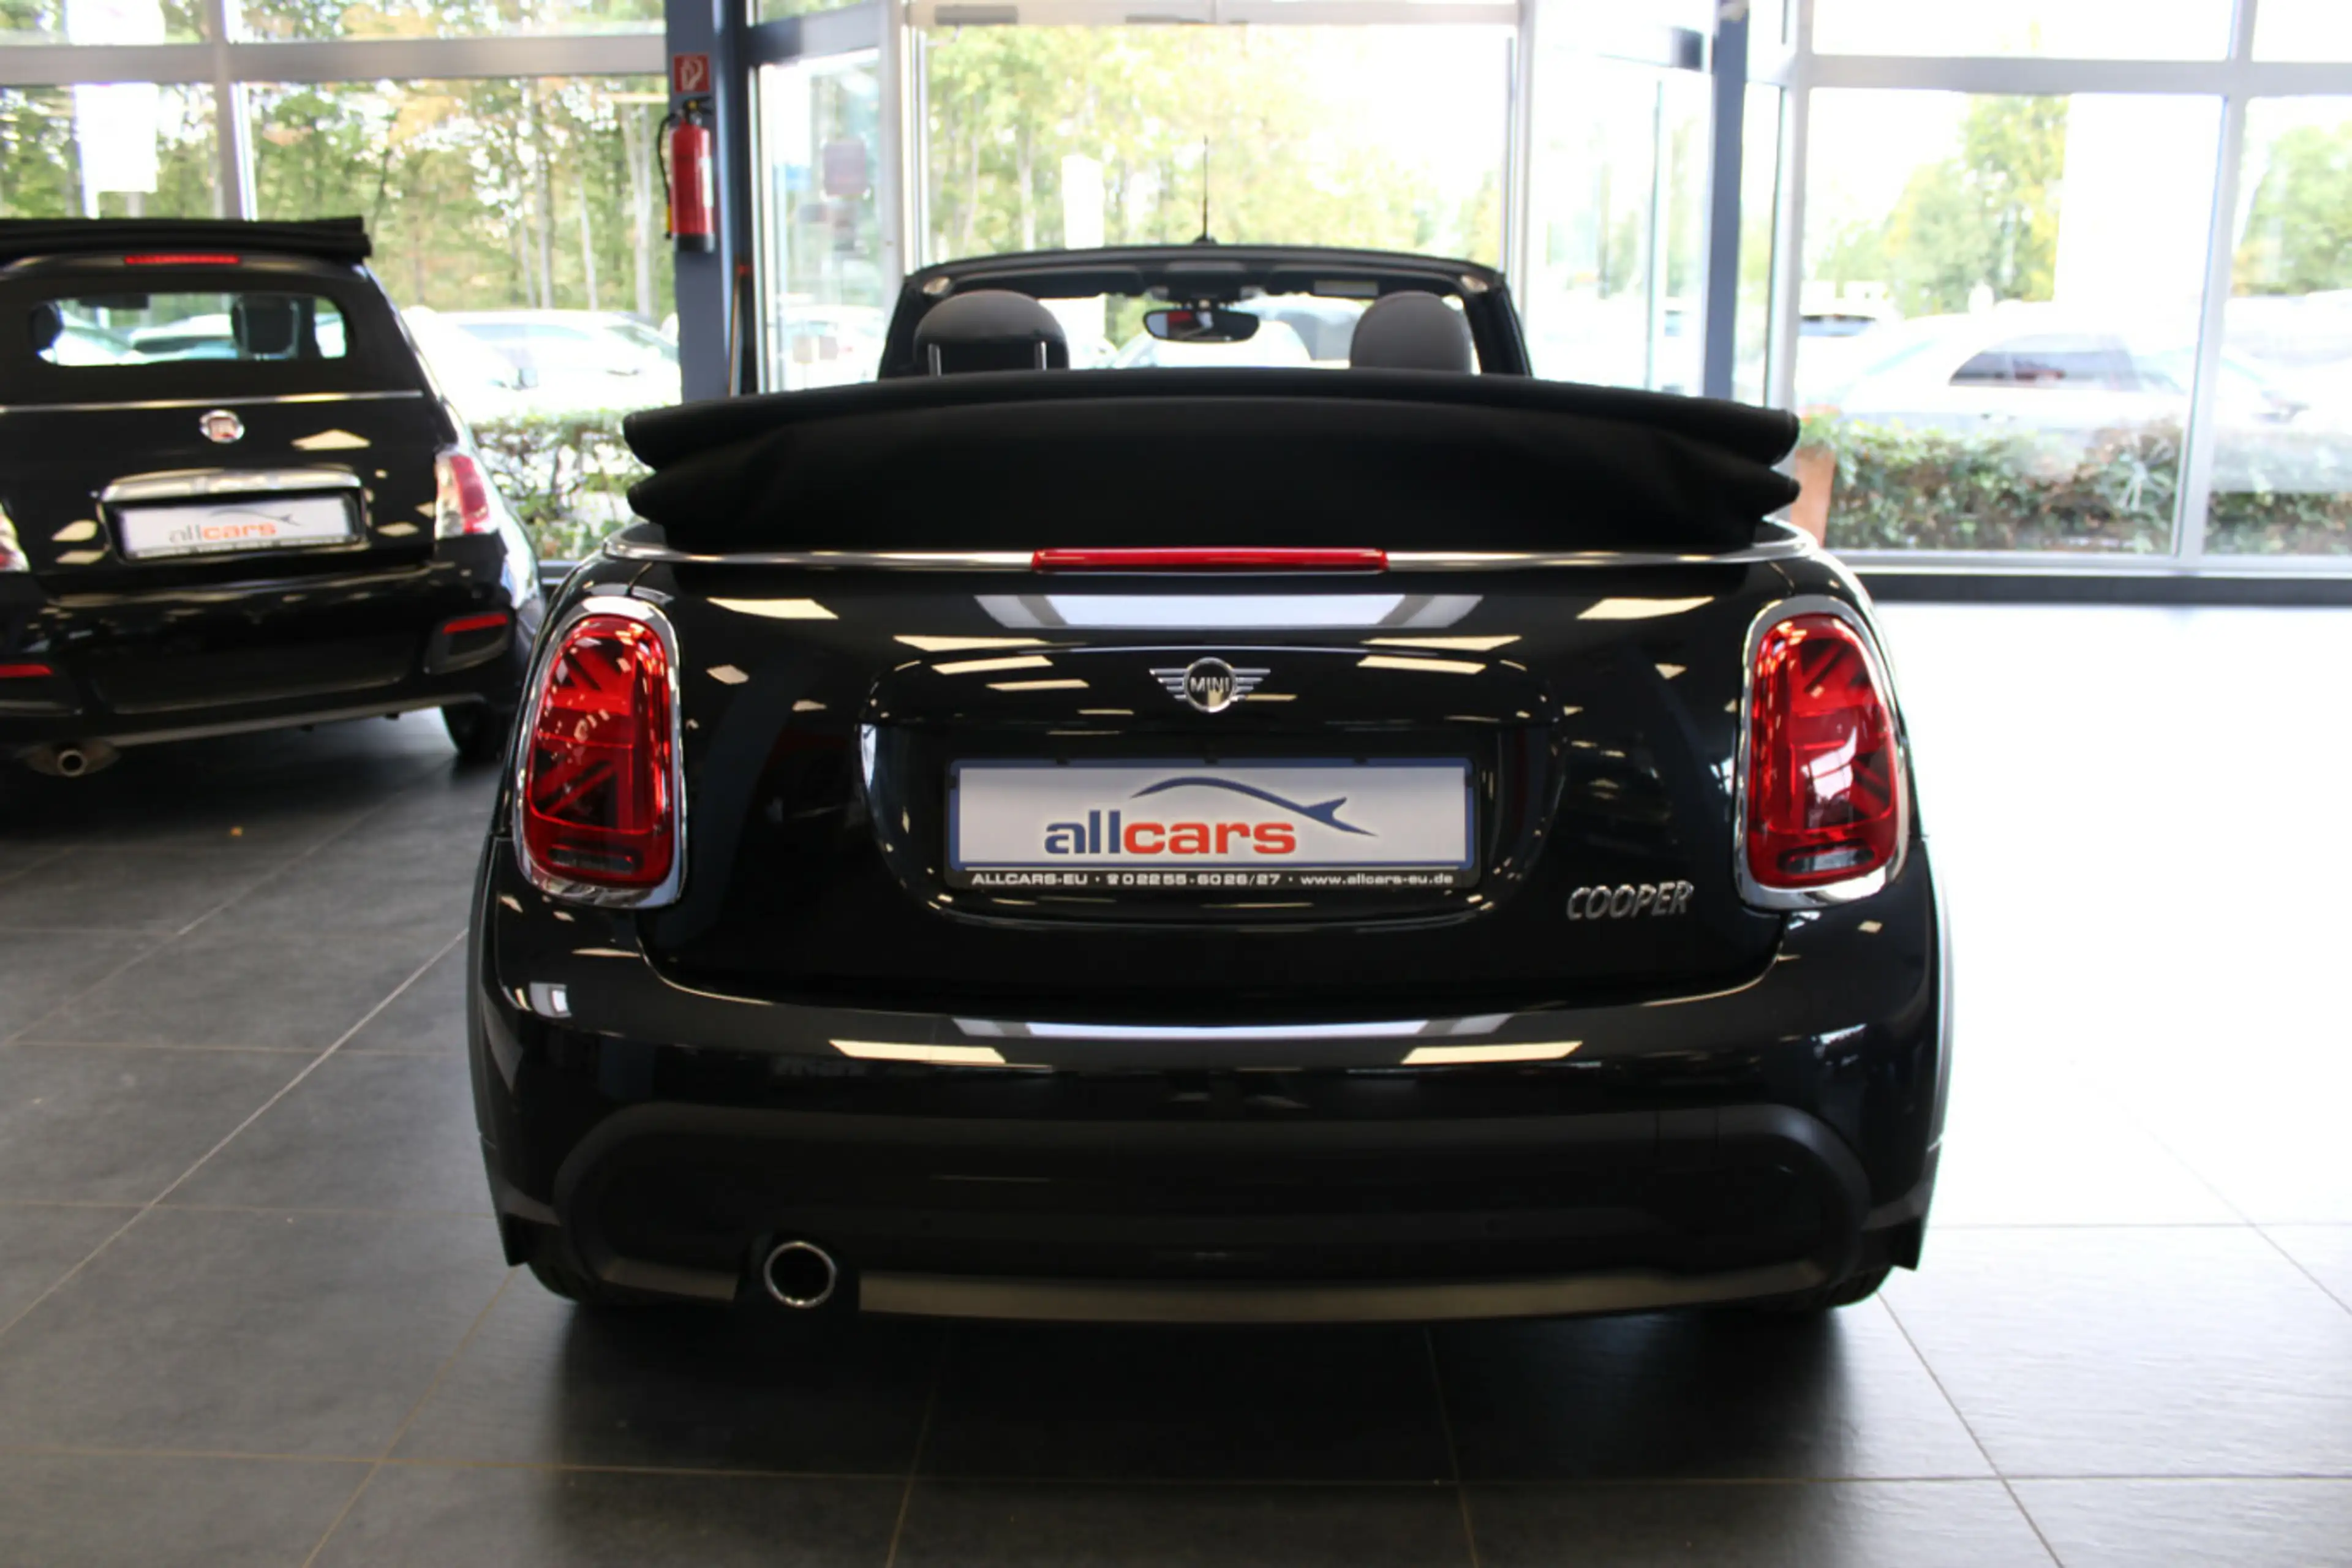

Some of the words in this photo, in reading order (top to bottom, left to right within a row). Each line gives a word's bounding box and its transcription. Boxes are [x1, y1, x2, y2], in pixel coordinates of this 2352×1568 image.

[169, 522, 277, 543] allcars
[1190, 677, 1230, 692] MINI
[1044, 810, 1296, 854] allcars
[1300, 873, 1453, 885] www.allcars-eu.de
[1566, 880, 1694, 919] COOPER
